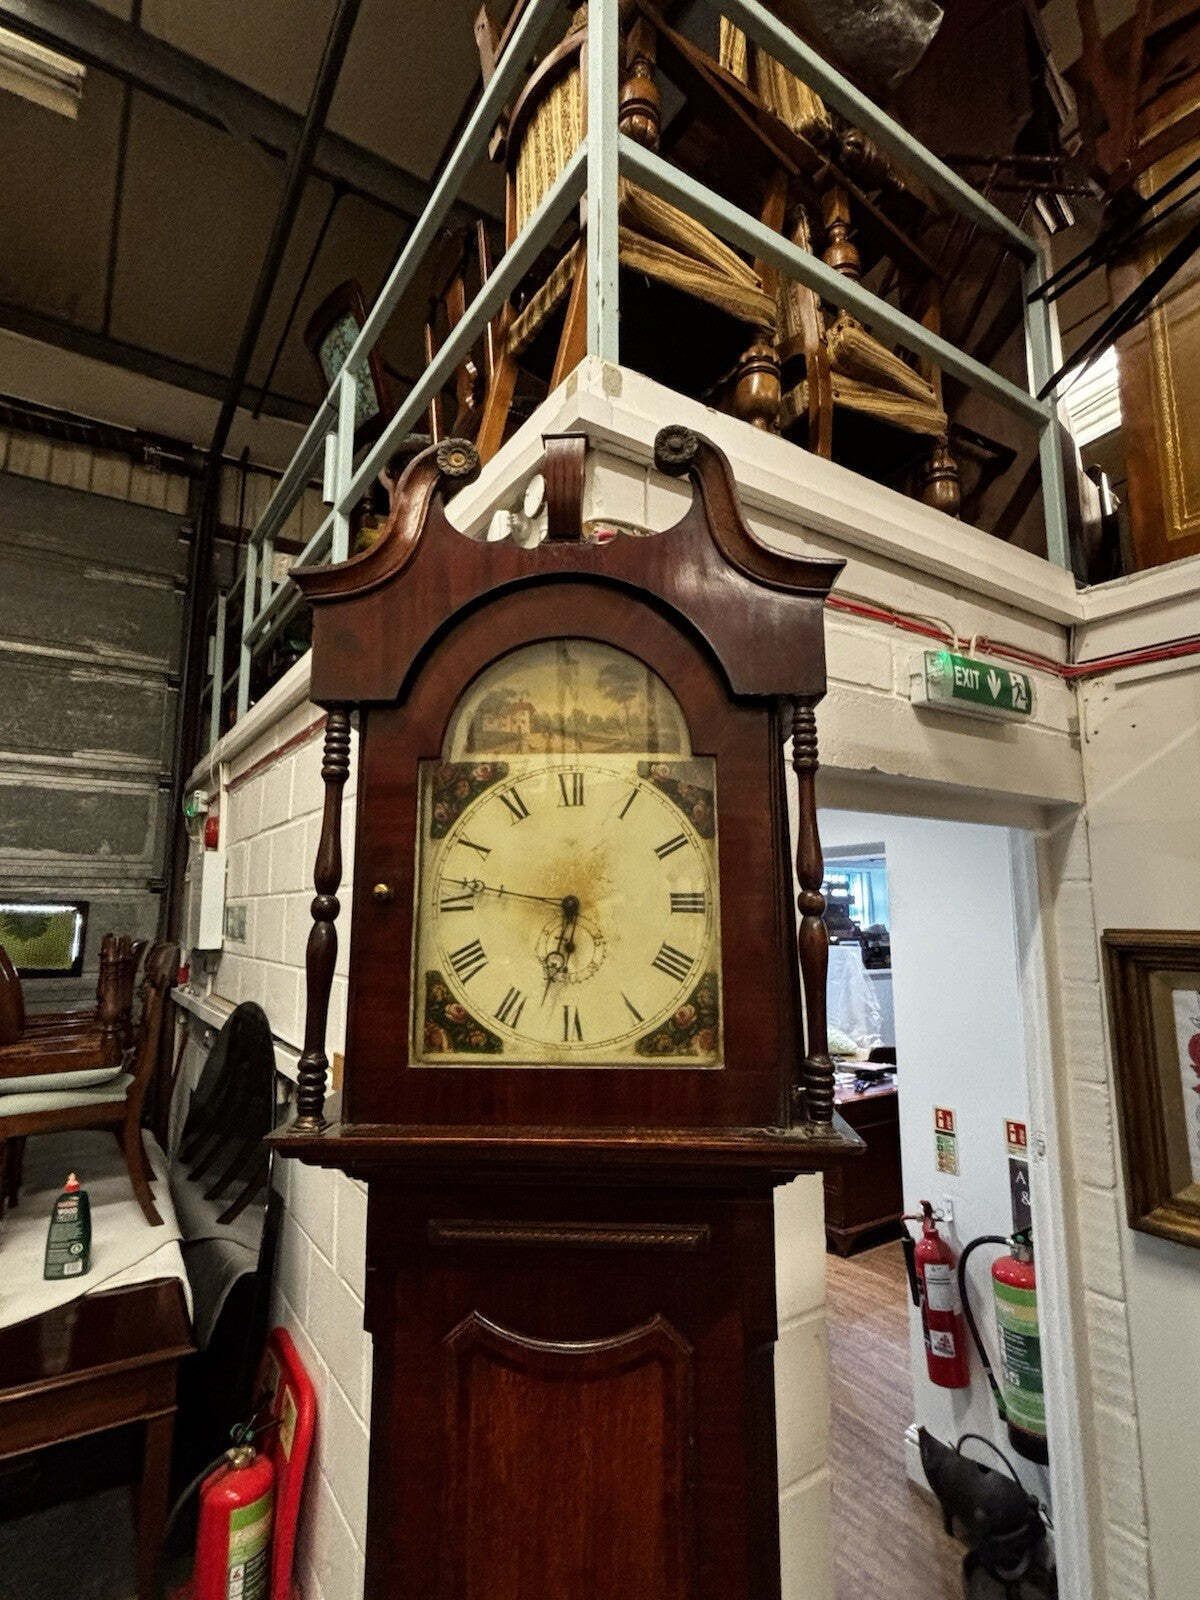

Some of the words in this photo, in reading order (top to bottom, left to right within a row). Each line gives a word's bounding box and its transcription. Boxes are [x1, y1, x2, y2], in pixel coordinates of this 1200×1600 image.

[954, 665, 980, 690] EXIT
[618, 783, 643, 820] I
[654, 832, 689, 861] II
[670, 892, 706, 914] III
[449, 938, 489, 985] VIII
[651, 941, 696, 983] IIII
[494, 985, 528, 1029] VII
[561, 1004, 585, 1042] VI
